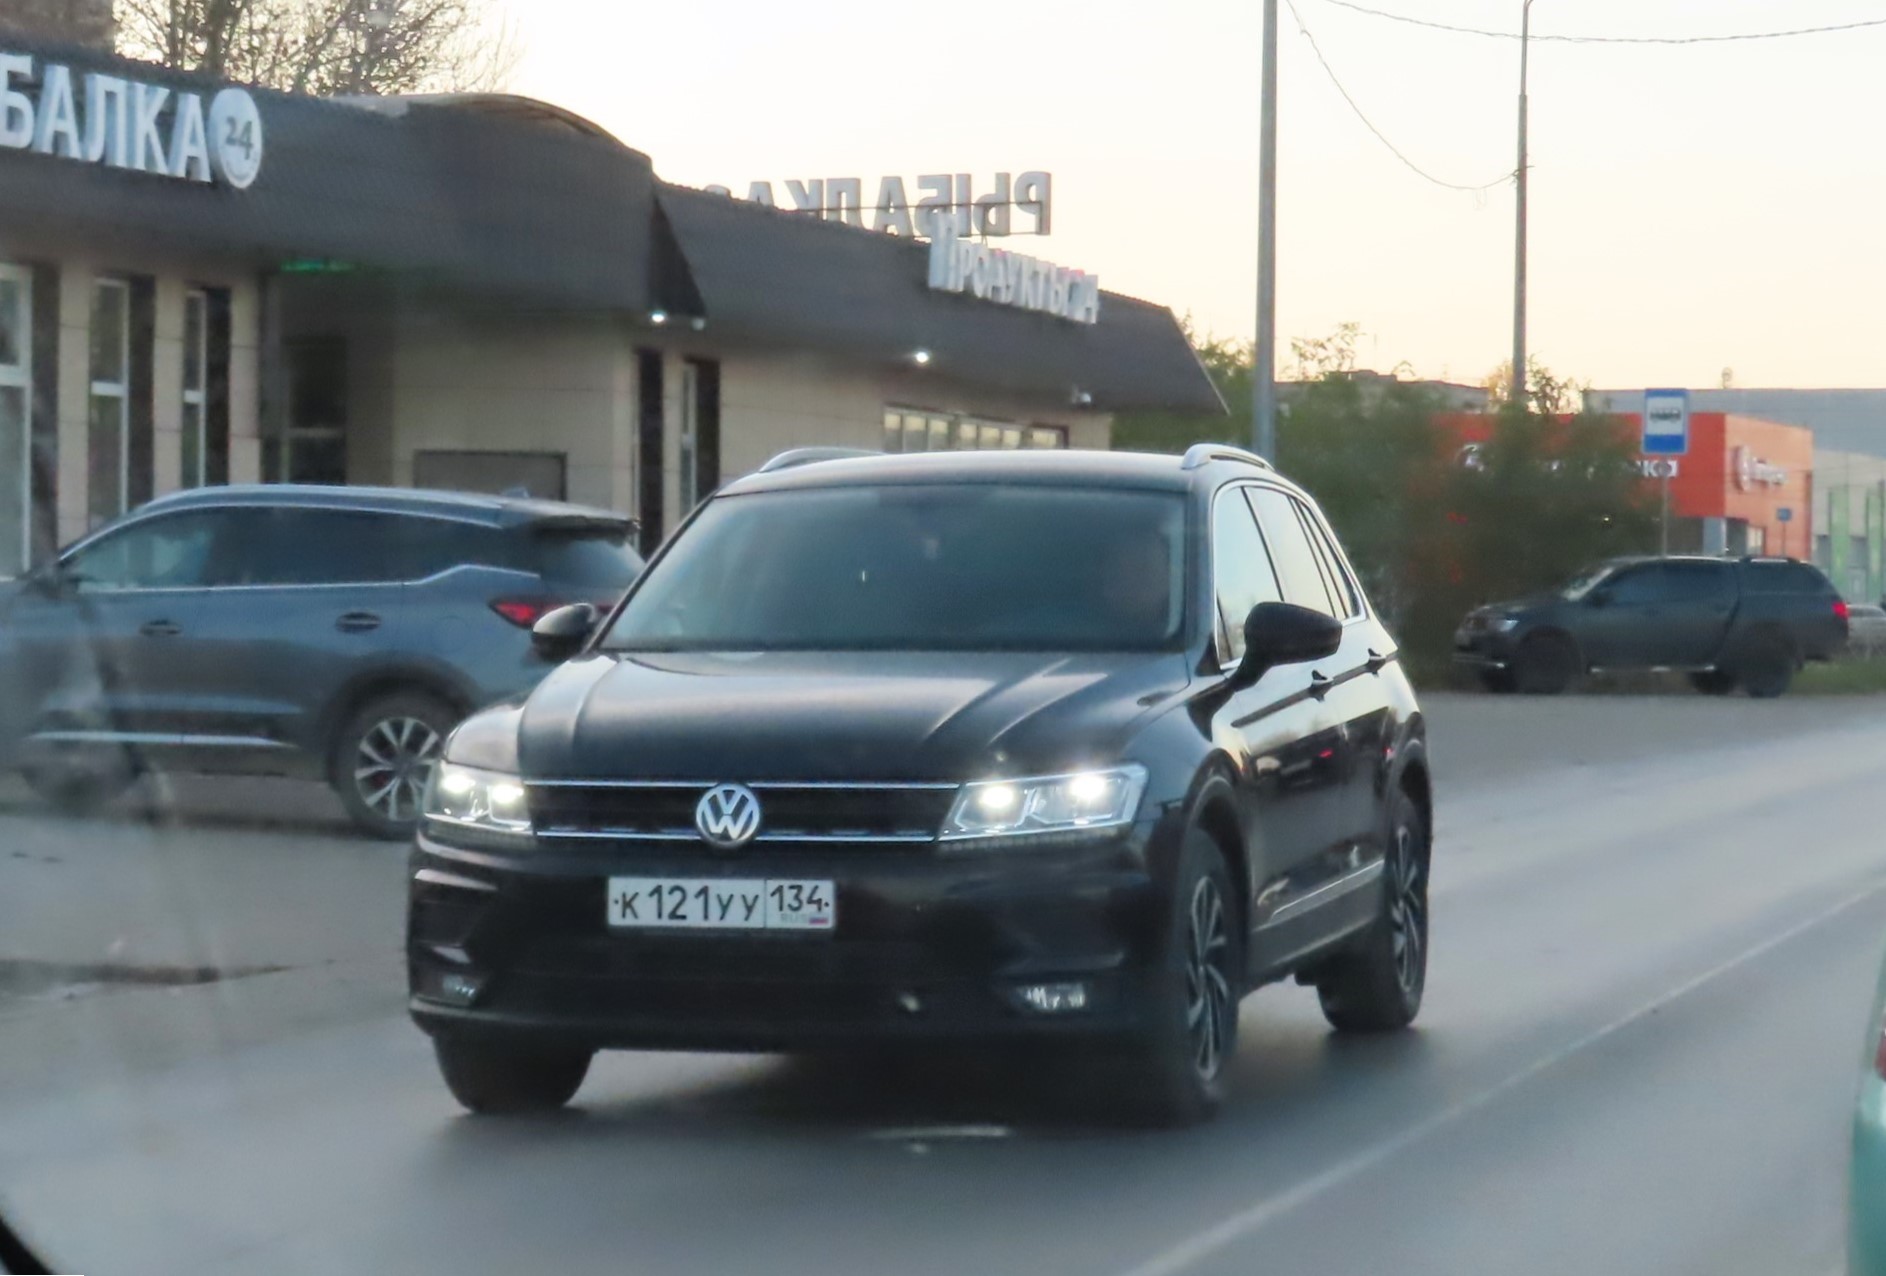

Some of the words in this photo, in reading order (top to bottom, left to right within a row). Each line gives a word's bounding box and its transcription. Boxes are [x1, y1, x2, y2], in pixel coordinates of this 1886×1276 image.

[225, 116, 253, 161] 24
[696, 784, 760, 846] VW
[770, 885, 823, 912] 134
